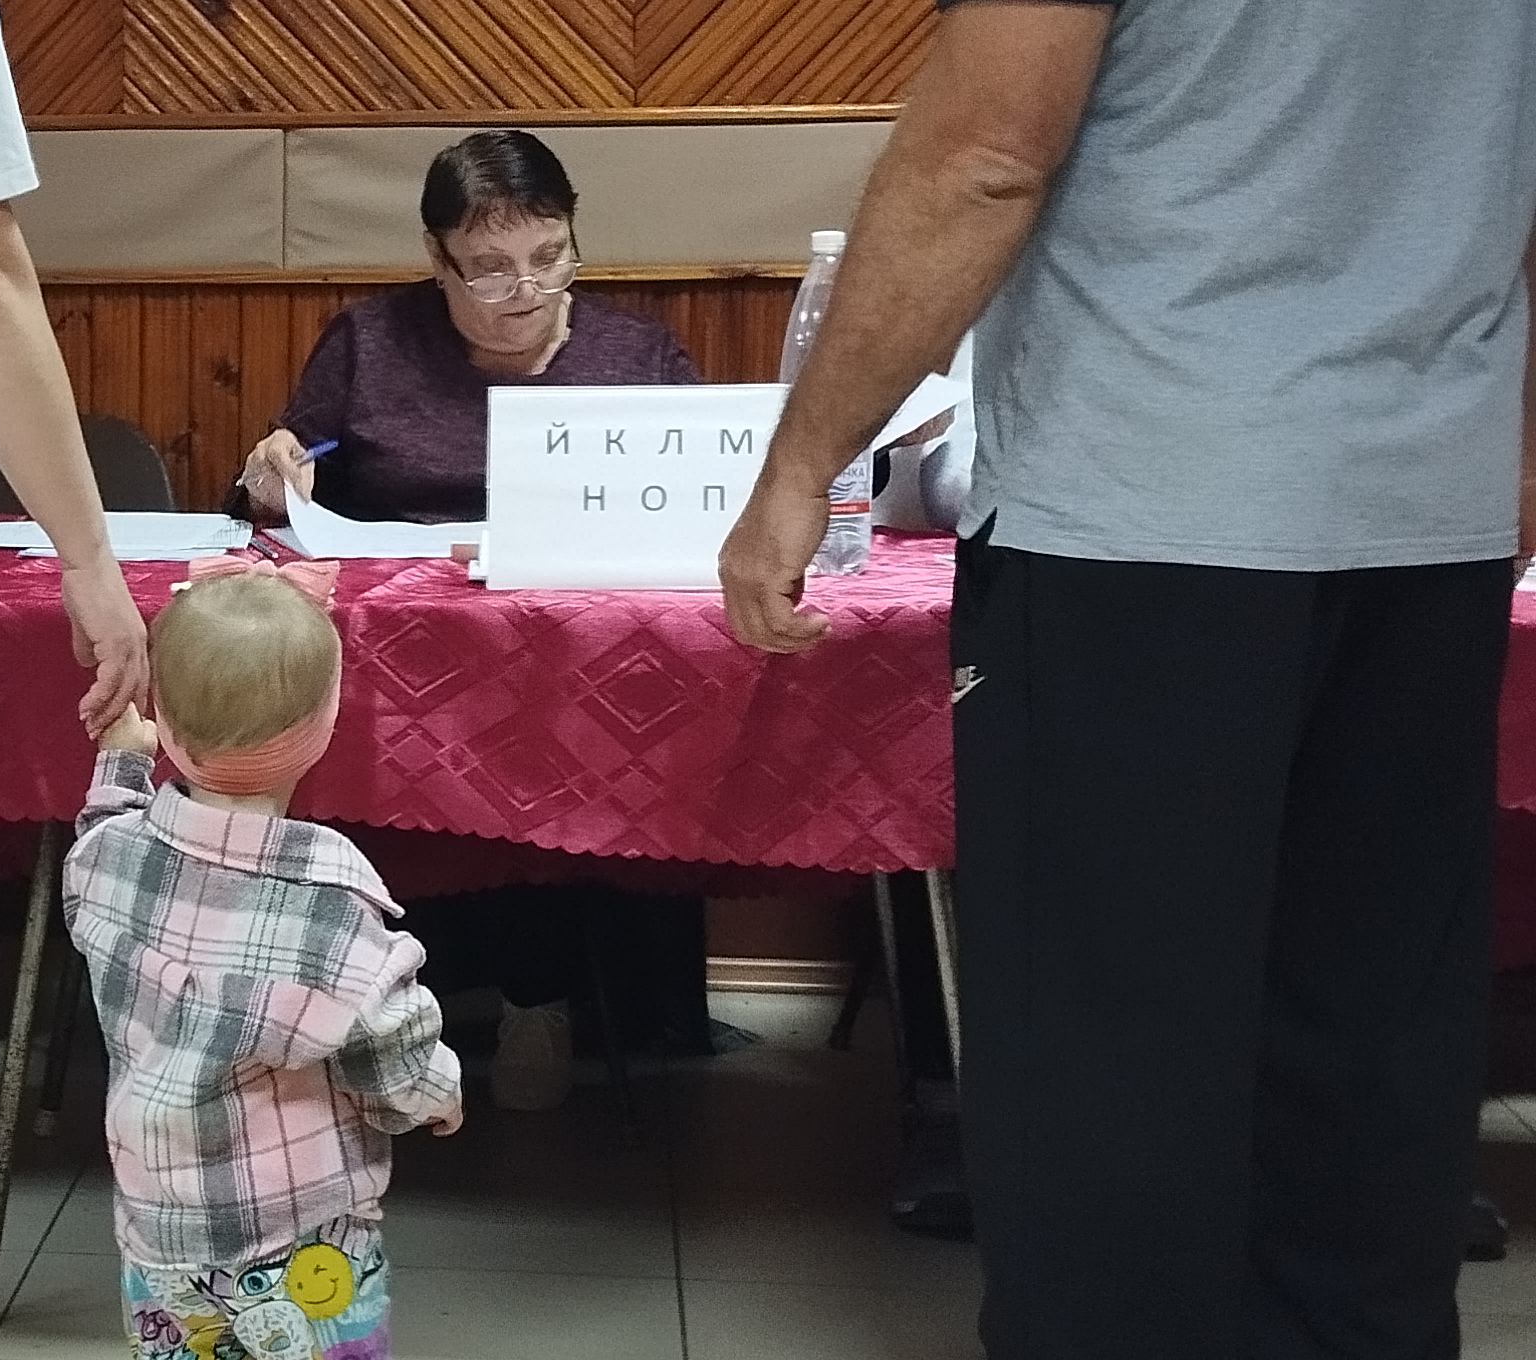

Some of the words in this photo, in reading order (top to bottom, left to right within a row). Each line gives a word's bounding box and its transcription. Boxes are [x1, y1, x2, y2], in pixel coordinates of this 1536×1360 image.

[546, 422, 570, 455] Й
[605, 429, 626, 455] К
[658, 429, 683, 455] Л
[719, 429, 753, 455] М
[583, 485, 605, 511] Н
[641, 485, 667, 512] О
[703, 485, 725, 512] П
